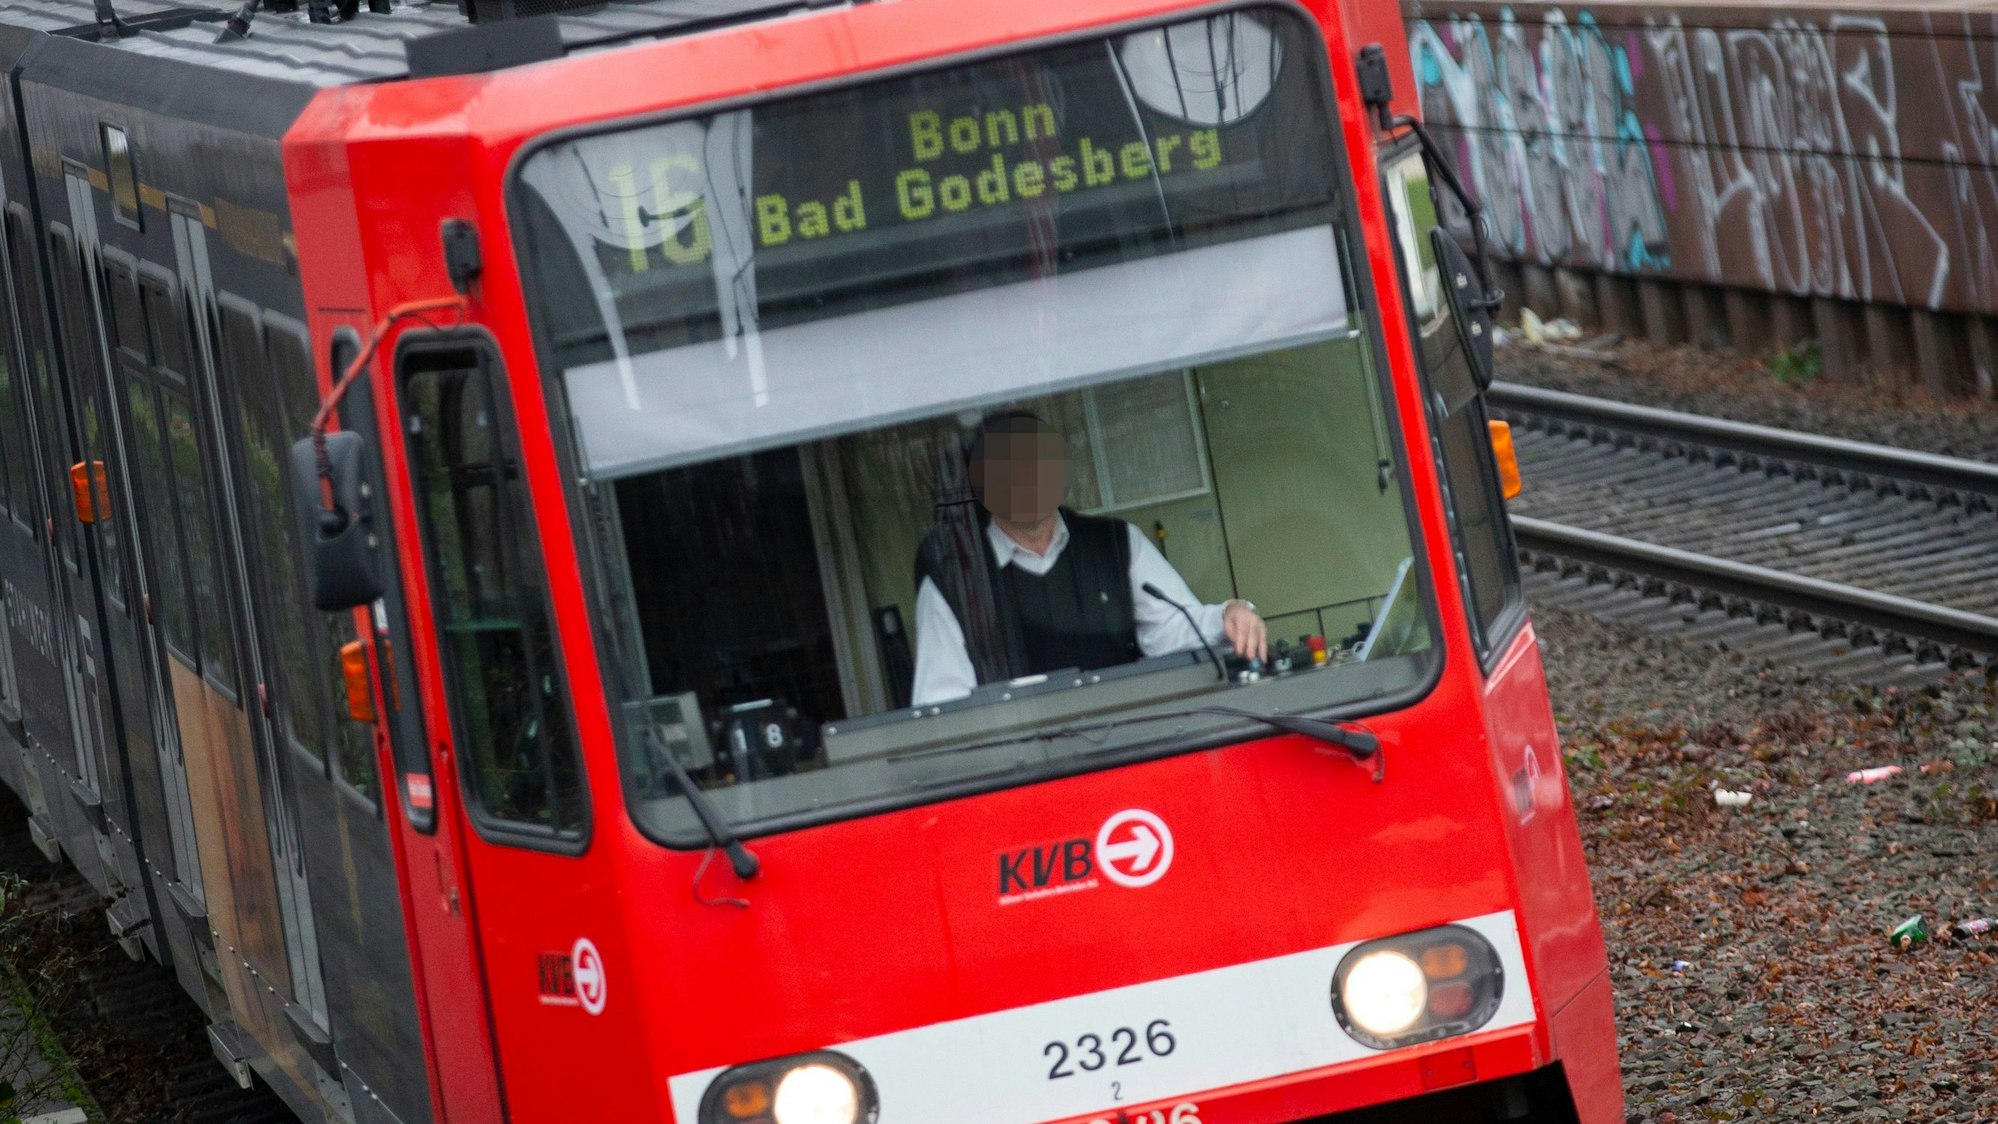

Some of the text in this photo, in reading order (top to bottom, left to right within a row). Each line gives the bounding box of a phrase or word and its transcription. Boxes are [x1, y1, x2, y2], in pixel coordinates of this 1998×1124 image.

[908, 102, 1057, 162] Bonn
[608, 155, 712, 272] 16
[755, 126, 1222, 246] Bad Godesberg
[766, 723, 783, 748] 8
[999, 838, 1093, 894] KVB
[1043, 1018, 1176, 1080] 2326
[1111, 1080, 1123, 1101] 2
